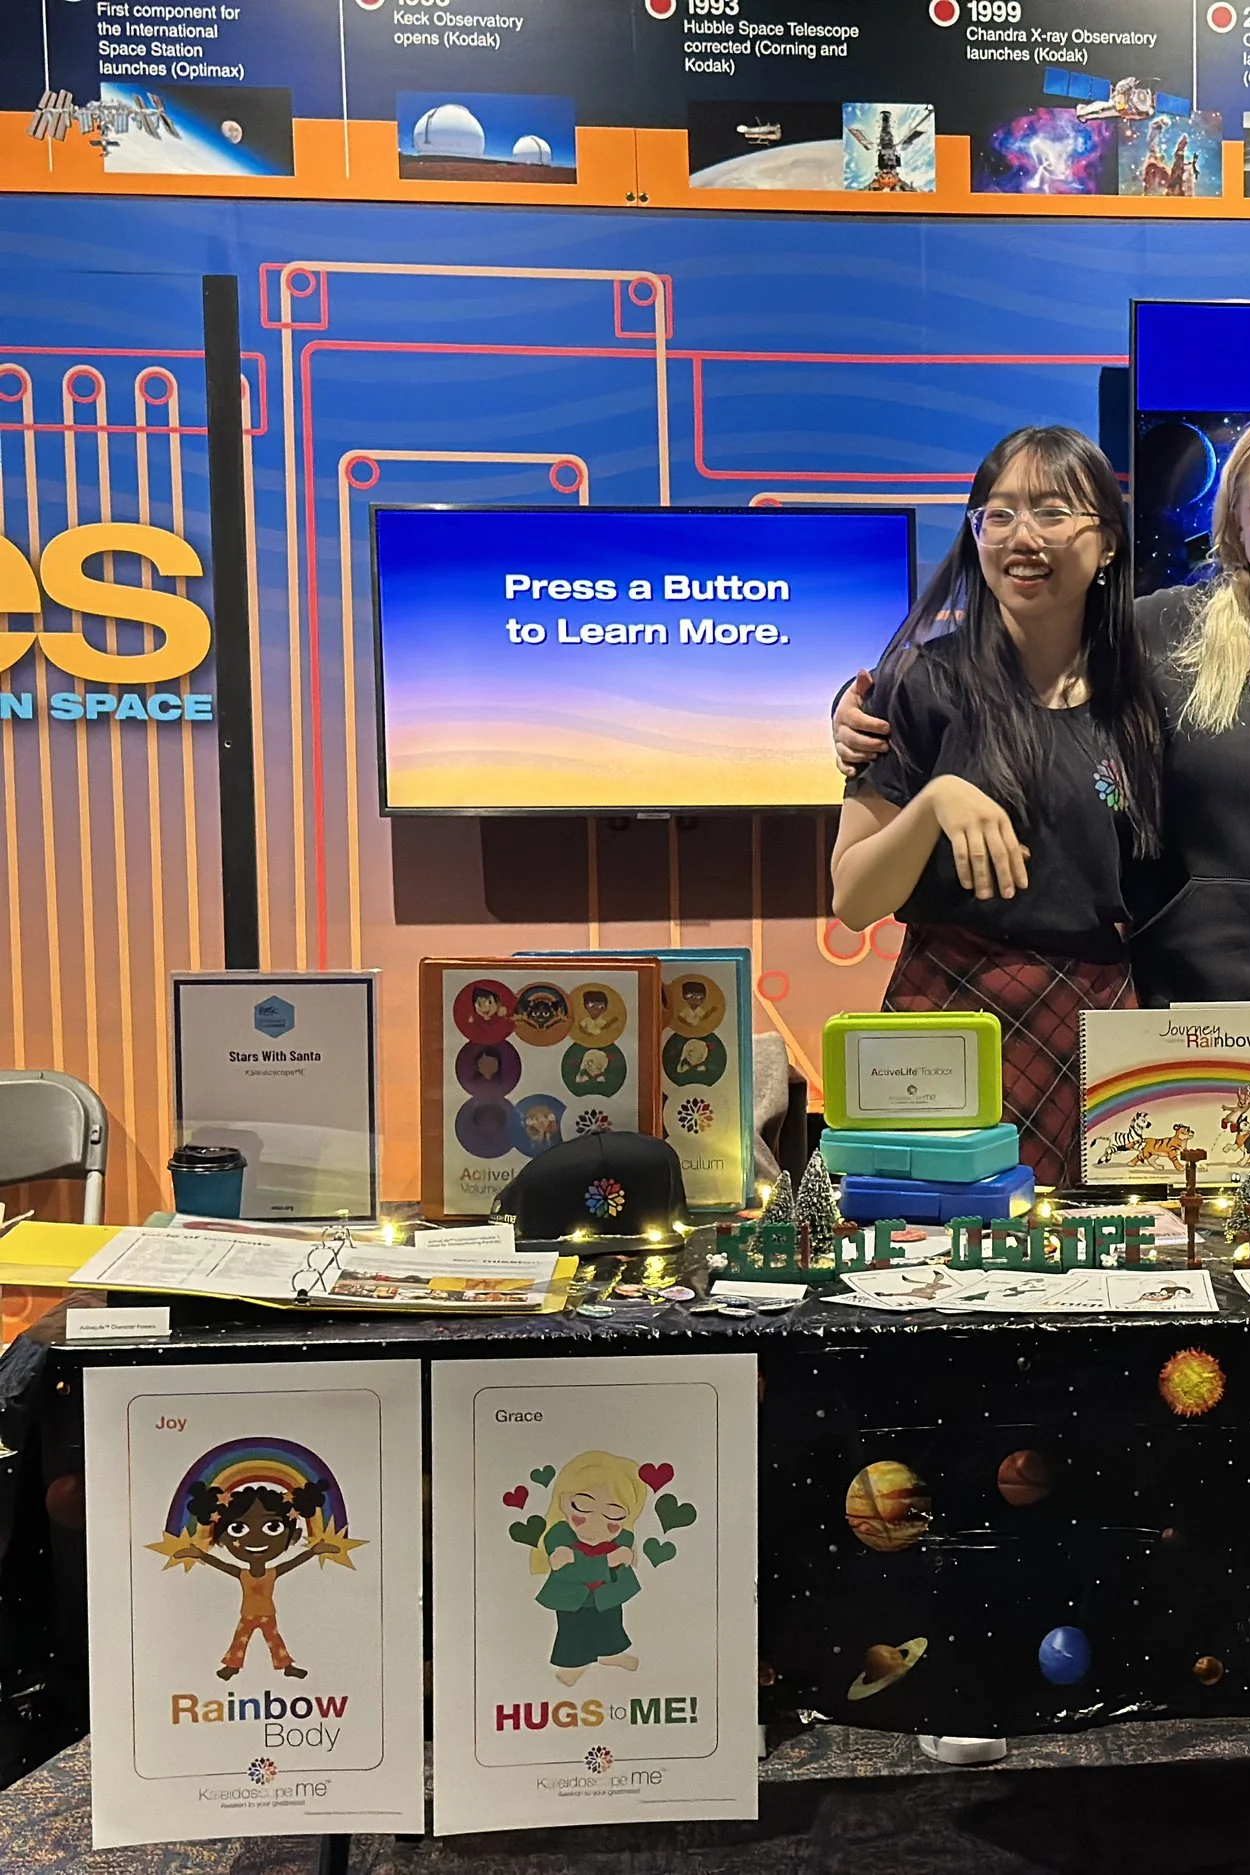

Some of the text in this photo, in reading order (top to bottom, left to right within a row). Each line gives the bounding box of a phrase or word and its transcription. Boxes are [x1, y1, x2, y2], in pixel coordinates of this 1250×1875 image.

[97, 2, 240, 20] First component for
[687, 0, 740, 15] 1993
[967, 0, 1022, 22] 1999
[98, 22, 218, 38] the International
[394, 11, 523, 31] Keck Observatory
[684, 20, 859, 40] Hubble Space Telescope
[394, 32, 500, 50] opens (Kodak)
[966, 27, 1157, 48] Chandra X-ray Observatory
[99, 41, 203, 57] Space Station
[684, 40, 848, 59] corrected (Corning and
[967, 46, 1088, 65] launches (Kodak)
[99, 60, 244, 81] launches (Optimax)
[685, 58, 735, 75] Kodak)
[505, 574, 789, 601] Press a Button
[506, 619, 789, 645] to Learn More.
[51, 693, 212, 721] SPACE
[1159, 1020, 1221, 1040] Journey
[229, 1051, 321, 1062] Stars With Santa
[156, 1416, 187, 1432] Joy
[496, 1410, 543, 1422] Grace
[171, 1690, 349, 1725] Rainbow
[496, 1697, 698, 1731] HUGS to ME!
[264, 1723, 340, 1752] Body
